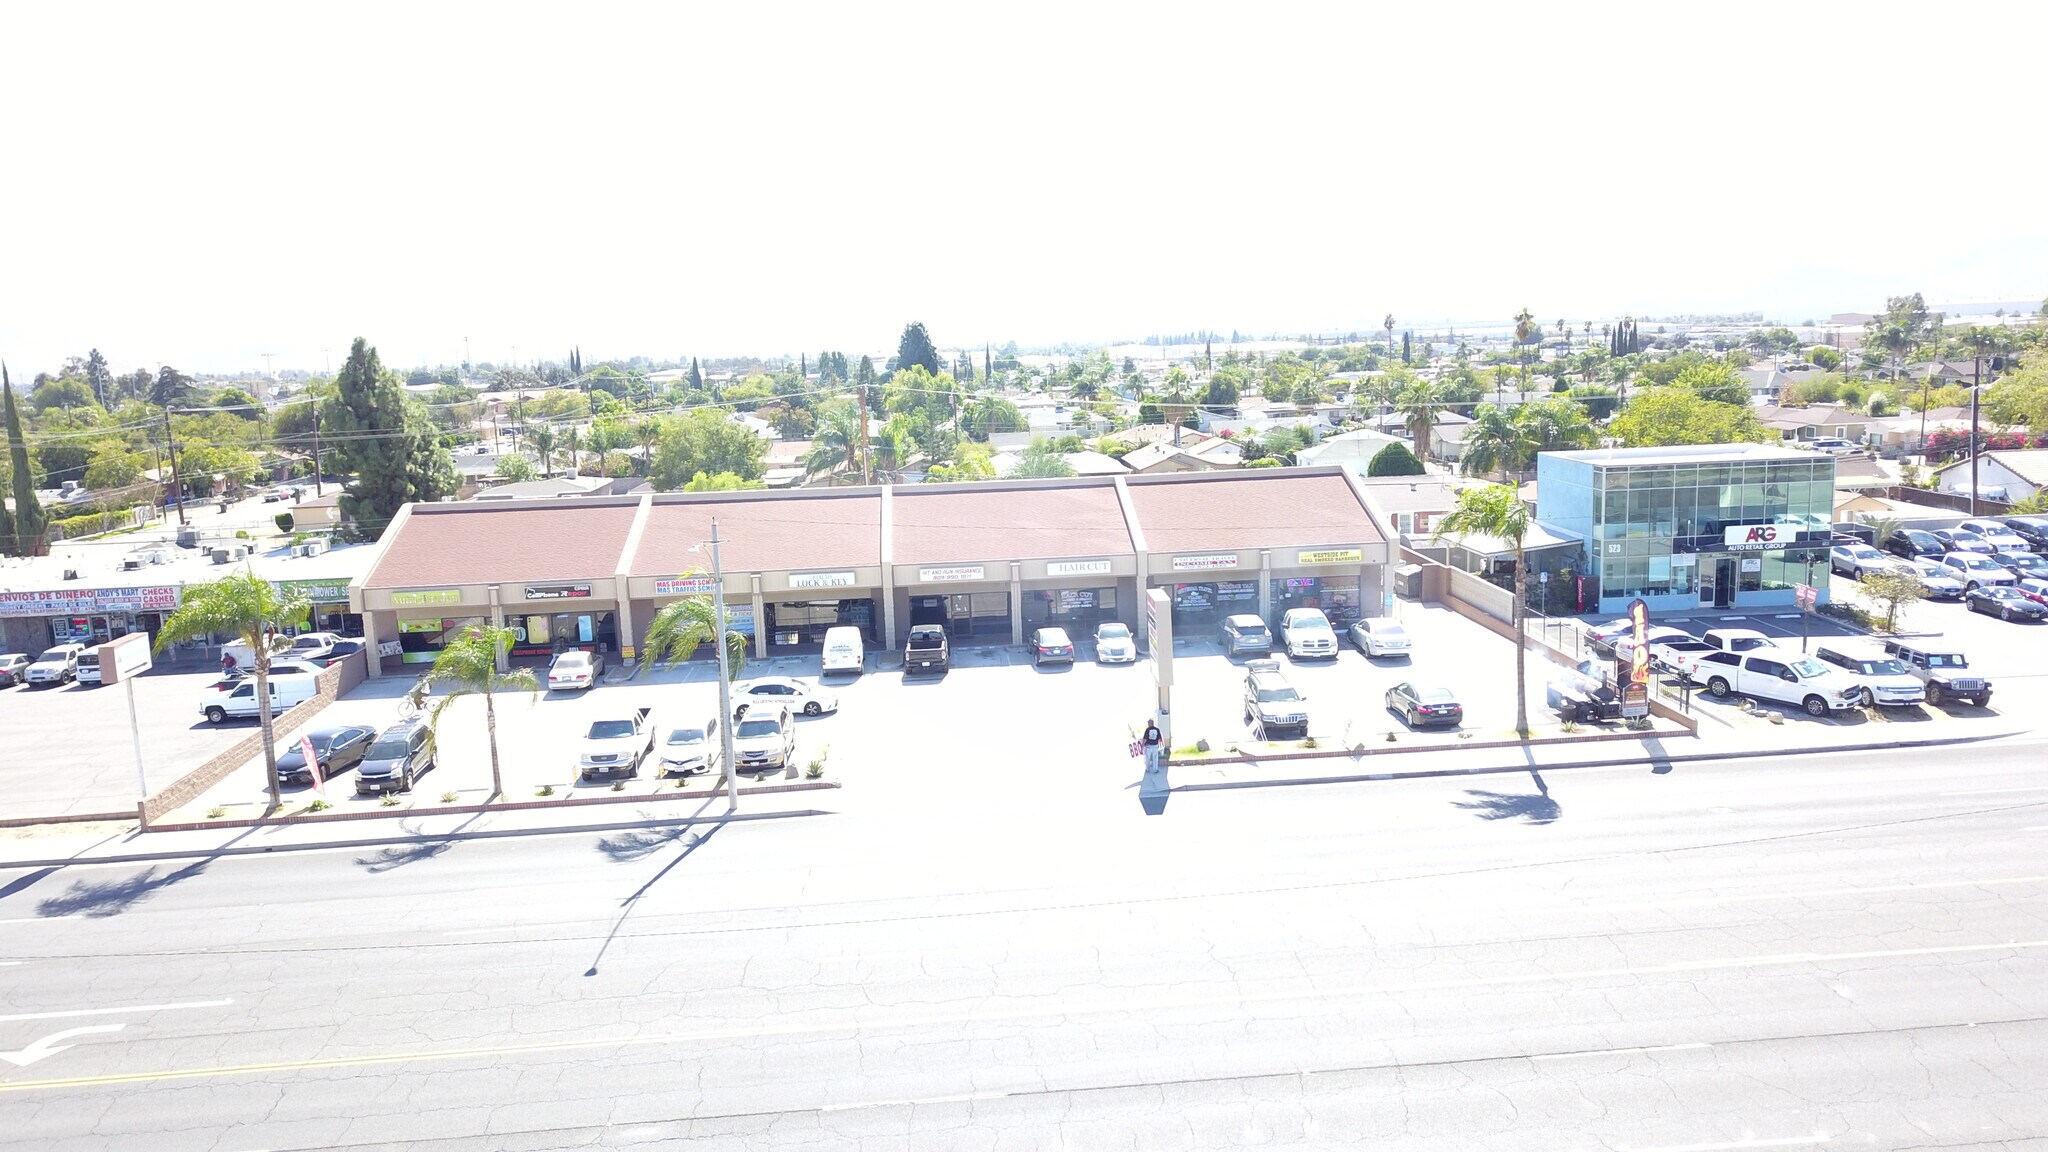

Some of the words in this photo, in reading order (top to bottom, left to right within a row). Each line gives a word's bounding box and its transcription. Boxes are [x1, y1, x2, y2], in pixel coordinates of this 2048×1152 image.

[1745, 526, 1777, 543] ARG
[1608, 544, 1621, 553] 523
[797, 579, 820, 587] LOCK
[831, 578, 848, 586] KEY
[39, 592, 53, 600] DE
[56, 590, 94, 599] DINERO
[96, 589, 120, 598] ANDY'S
[121, 588, 139, 596] MART
[142, 588, 174, 596] CHECKS
[143, 595, 175, 603] CASHED
